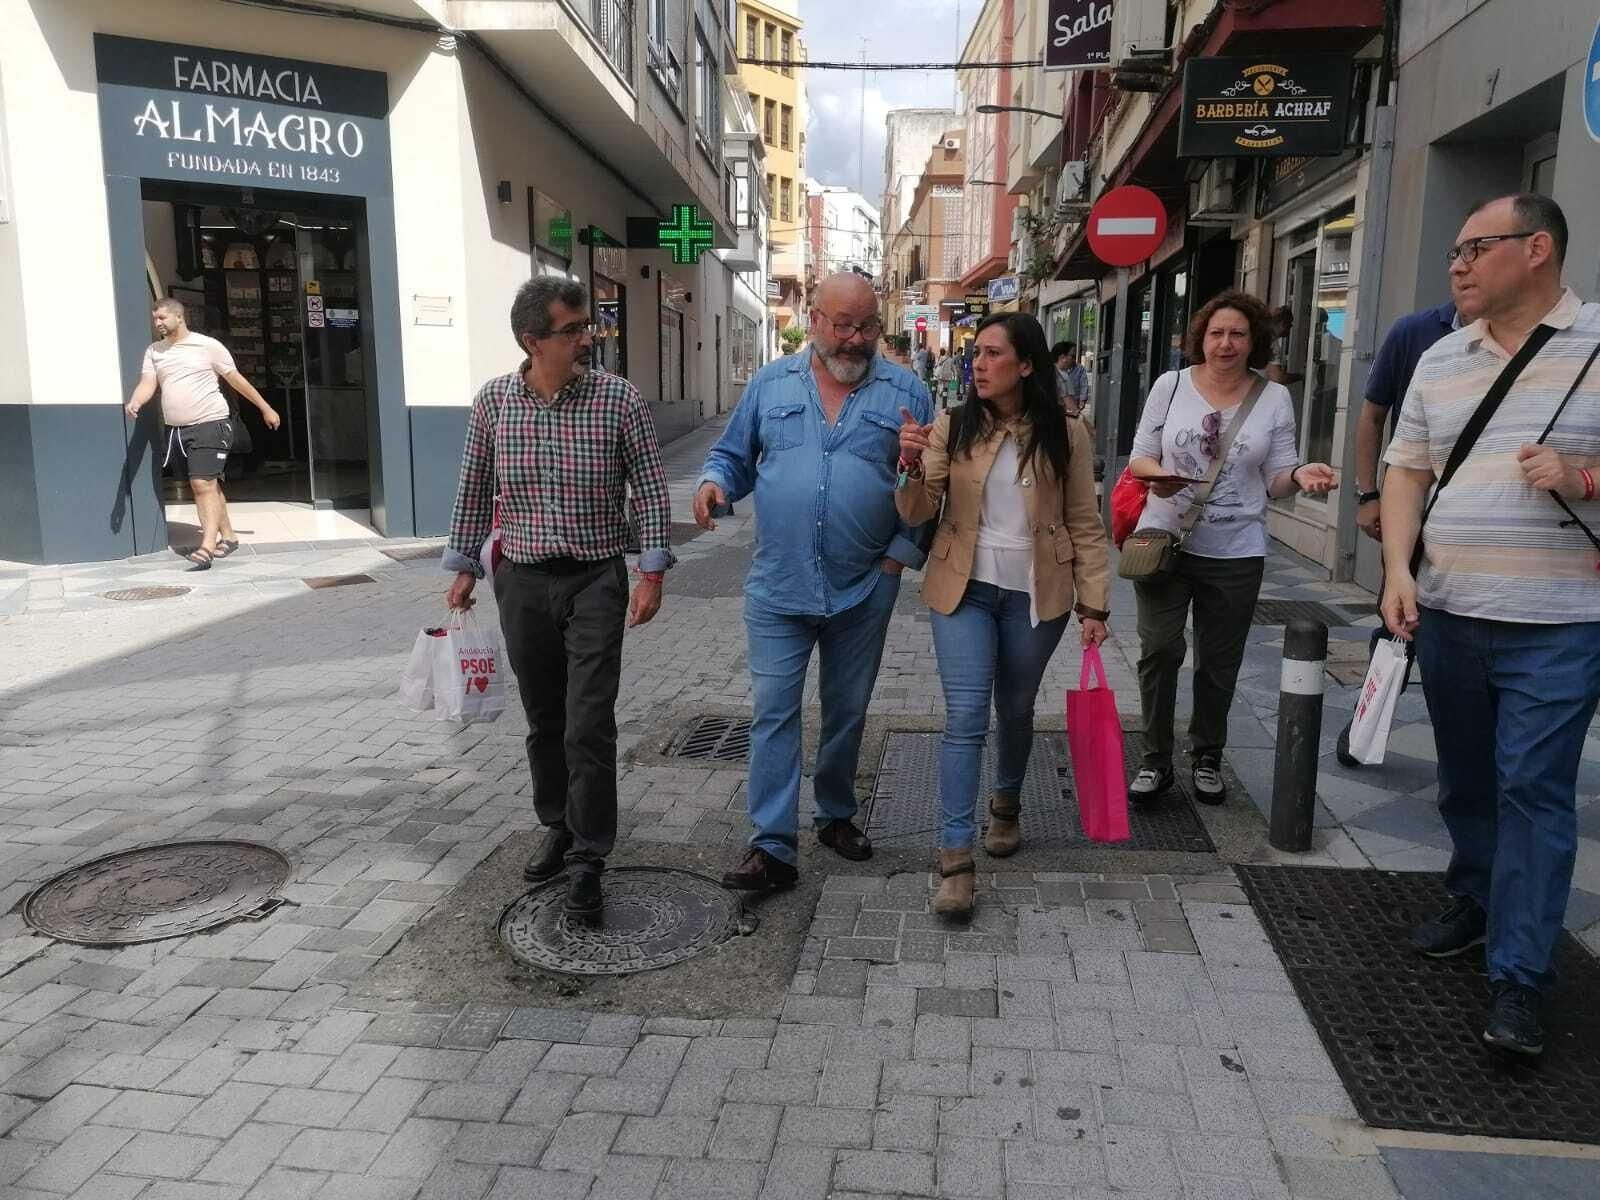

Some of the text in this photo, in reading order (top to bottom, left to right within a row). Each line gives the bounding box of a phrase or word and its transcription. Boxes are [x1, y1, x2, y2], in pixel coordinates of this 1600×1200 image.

[173, 56, 323, 105] FARMACIA
[1196, 100, 1332, 118] BARBERÍA ACHRAF
[134, 99, 364, 159] ALMAGRO
[167, 151, 340, 183] FUNDADA EN 1843
[461, 657, 497, 675] PSOE
